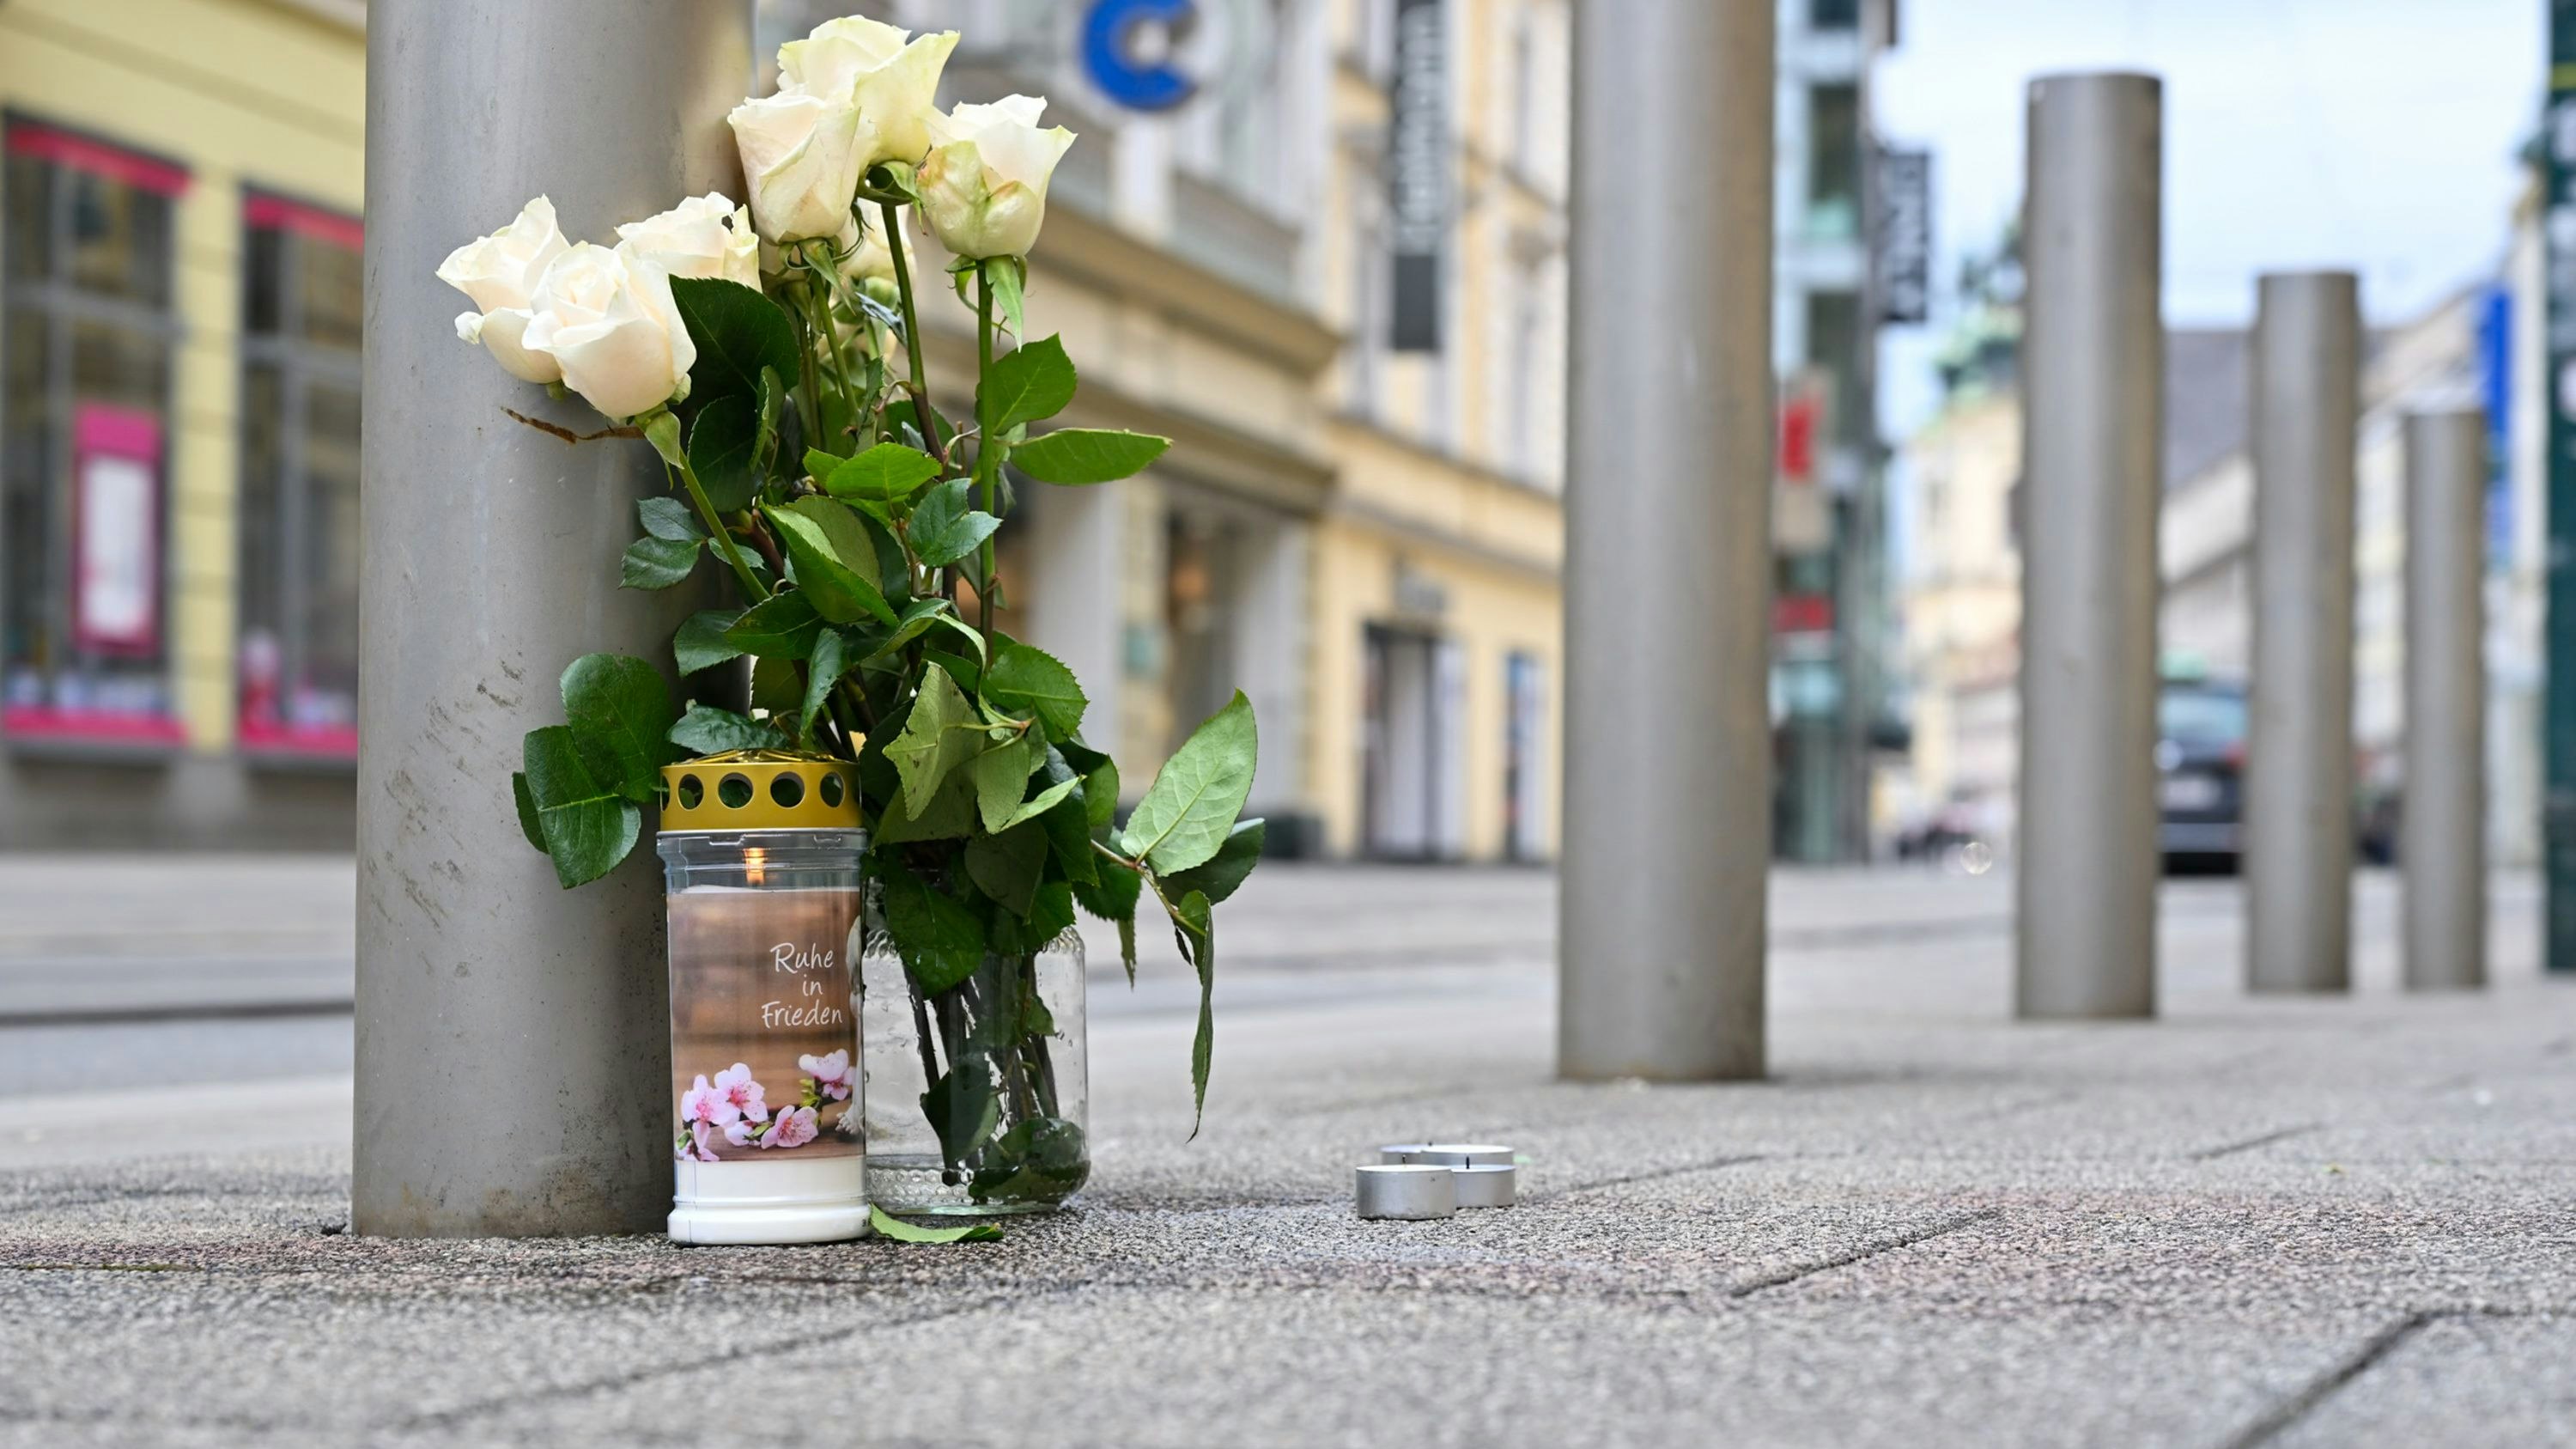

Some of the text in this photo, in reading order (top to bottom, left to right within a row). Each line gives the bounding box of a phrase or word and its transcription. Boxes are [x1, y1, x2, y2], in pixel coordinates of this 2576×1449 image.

[769, 942, 834, 974] Ruhe
[802, 973, 823, 996] in
[761, 999, 843, 1029] Frieden
